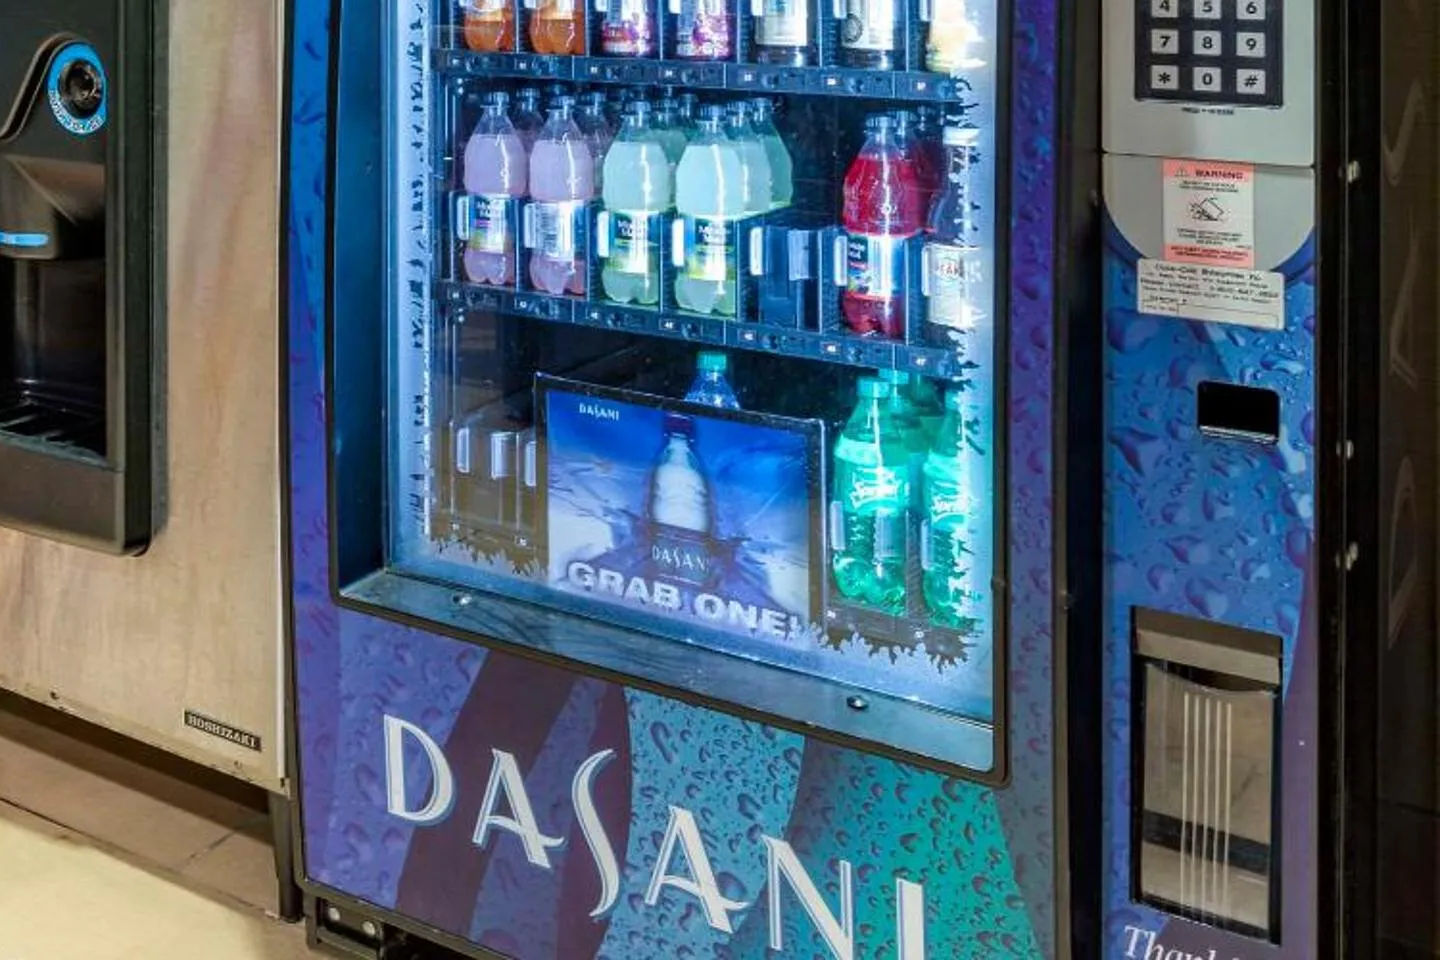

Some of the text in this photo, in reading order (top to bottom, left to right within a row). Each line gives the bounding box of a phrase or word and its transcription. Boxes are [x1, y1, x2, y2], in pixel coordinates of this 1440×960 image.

[1159, 0, 1170, 12] 4
[1202, 0, 1213, 13] 5
[1246, 2, 1257, 15] 6
[1160, 35, 1171, 48] 7
[1202, 36, 1213, 49] 8
[1246, 38, 1257, 51] 9
[1202, 73, 1213, 86] 0
[578, 402, 620, 422] DASANI
[567, 561, 800, 641] GRAB ONE!
[384, 714, 925, 960] DASANI
